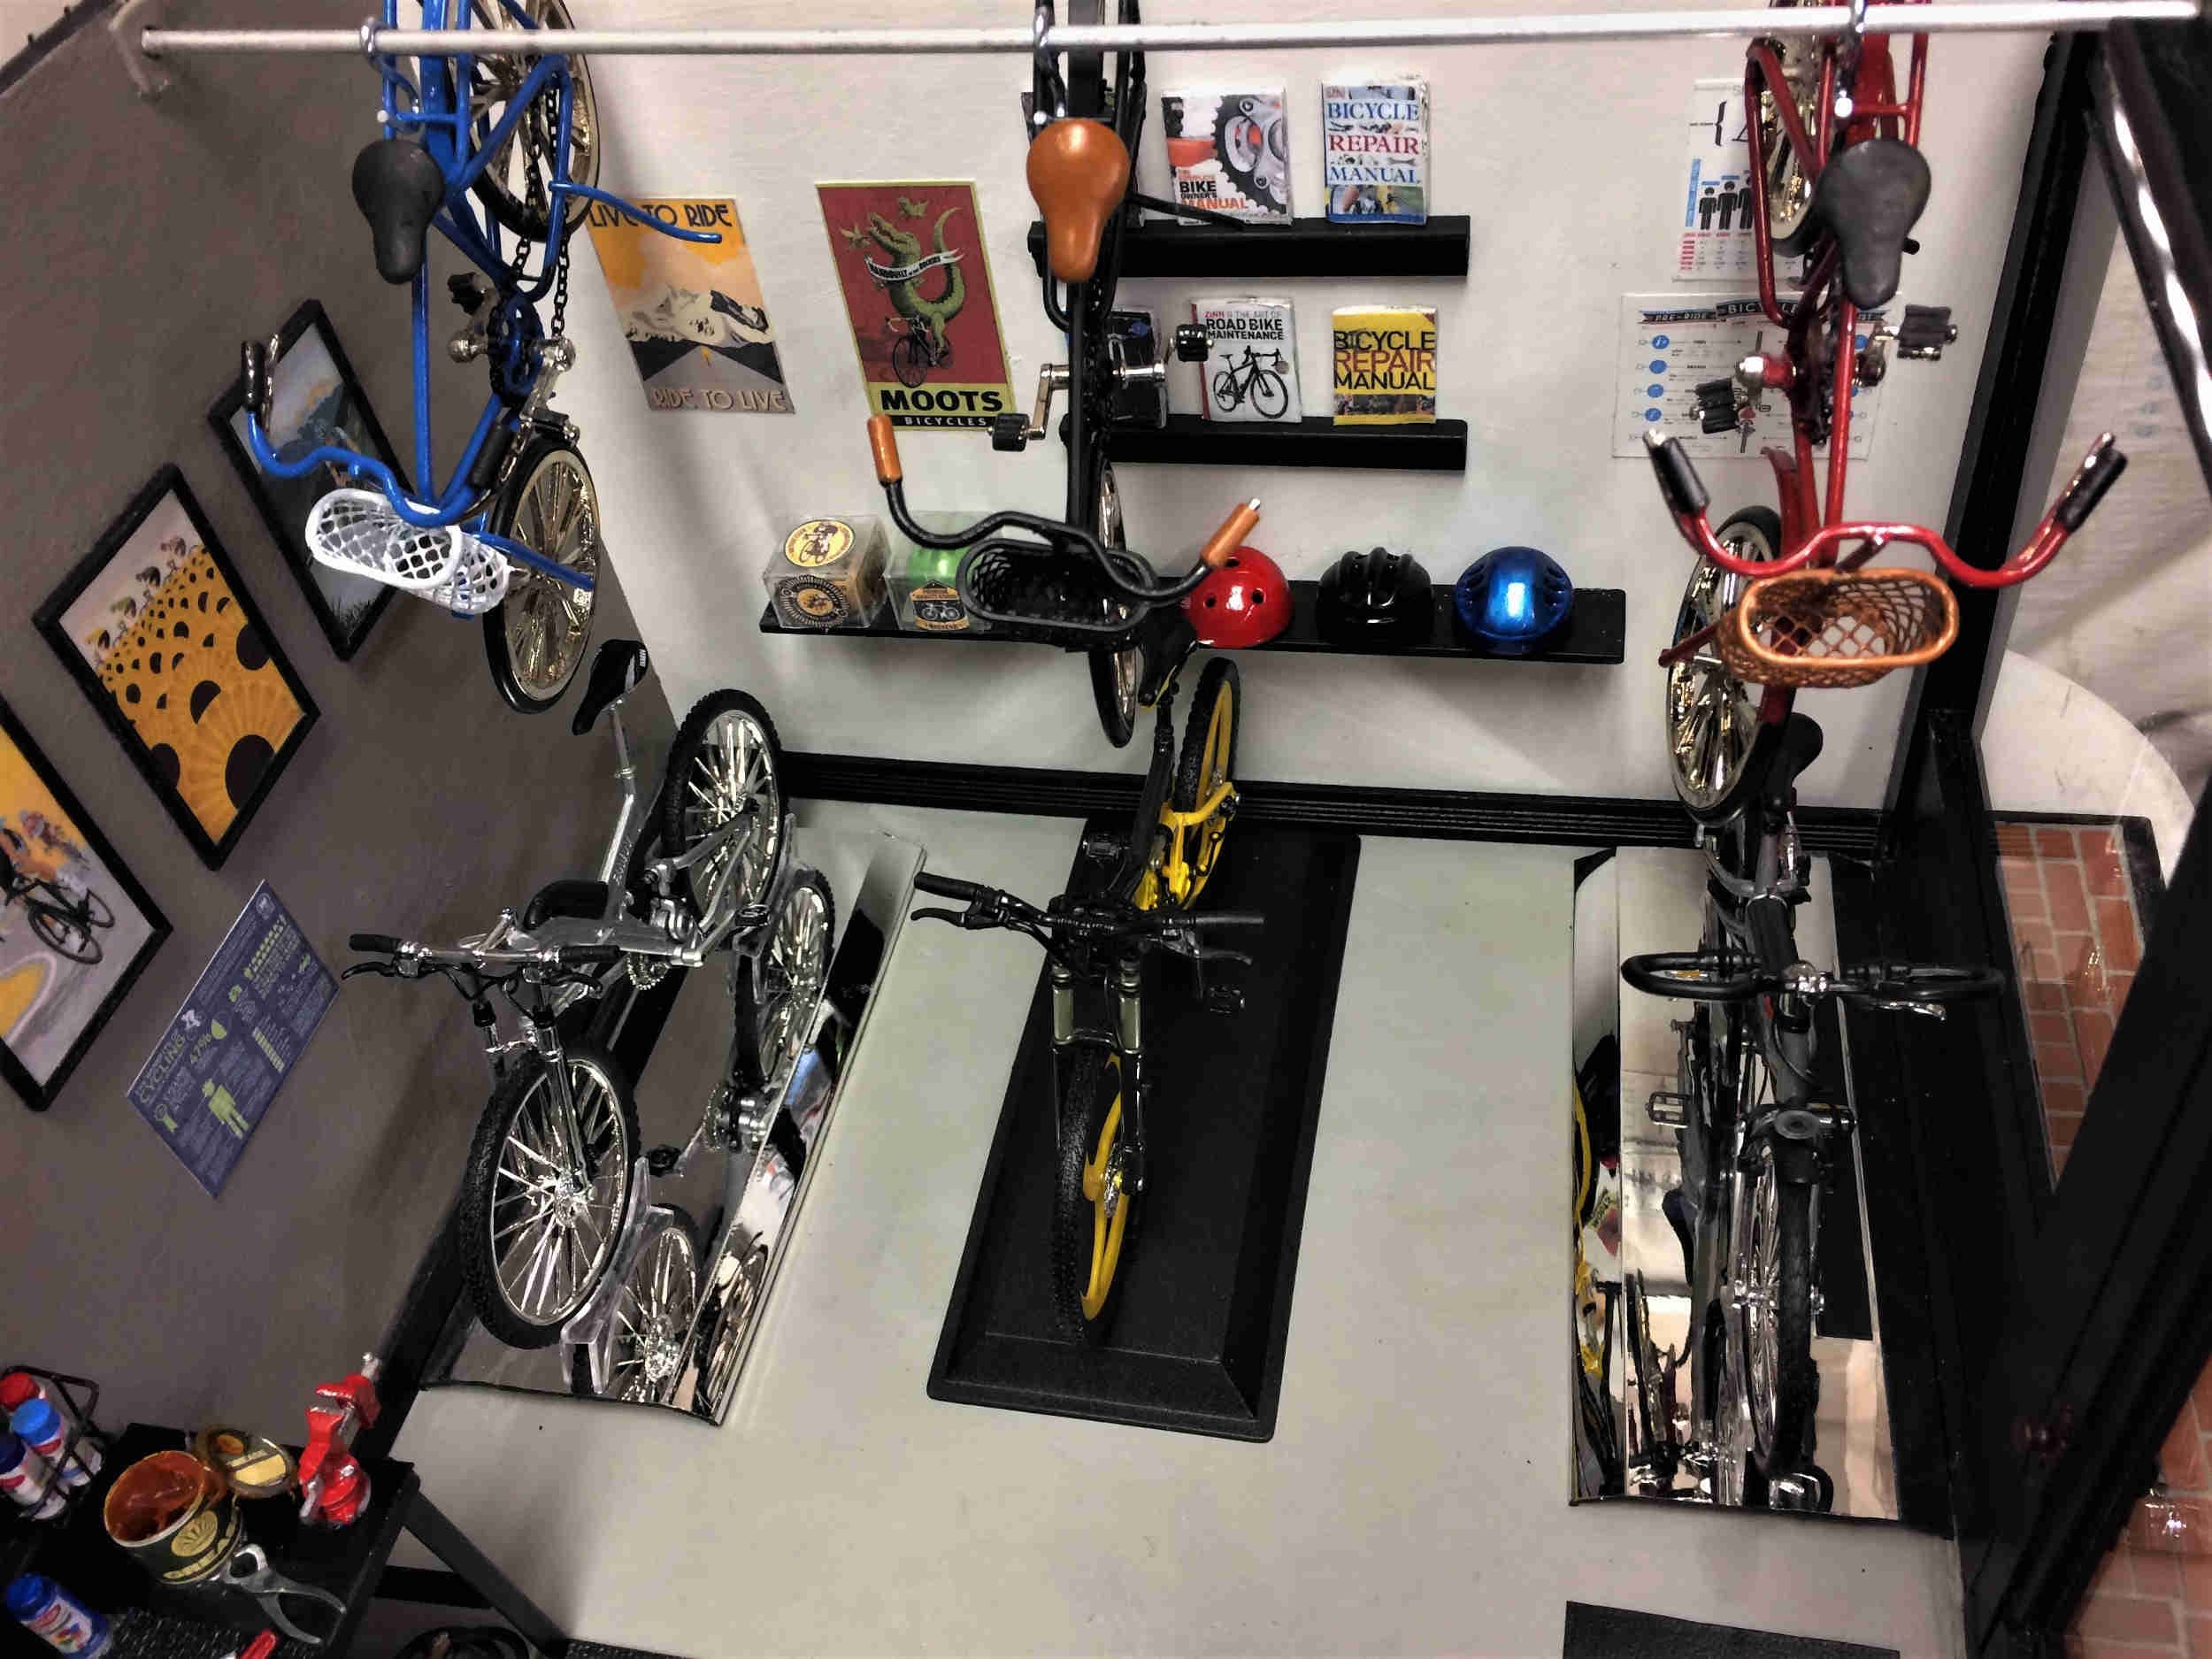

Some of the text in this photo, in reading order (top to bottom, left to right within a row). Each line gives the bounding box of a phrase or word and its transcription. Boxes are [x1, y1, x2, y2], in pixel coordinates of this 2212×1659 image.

[1327, 102, 1419, 121] BICYCLE
[1329, 134, 1420, 154] REPAIR
[1329, 165, 1421, 185] MANUAL
[1179, 180, 1217, 193] BIKE
[1180, 197, 1248, 211] MANUAL
[684, 204, 733, 227] RIDE
[1206, 319, 1283, 331] ROAD BIKE
[1207, 330, 1284, 341] MAINTENANCE
[1333, 328, 1436, 351] BICYCLE
[1333, 349, 1436, 373] REPAIR
[1333, 372, 1436, 390] MANUAL
[651, 389, 788, 411] RIDE TO LIVE
[880, 389, 1003, 412] MOOTS
[904, 416, 987, 426] BICYCLES
[140, 1033, 185, 1104] CYCLING
